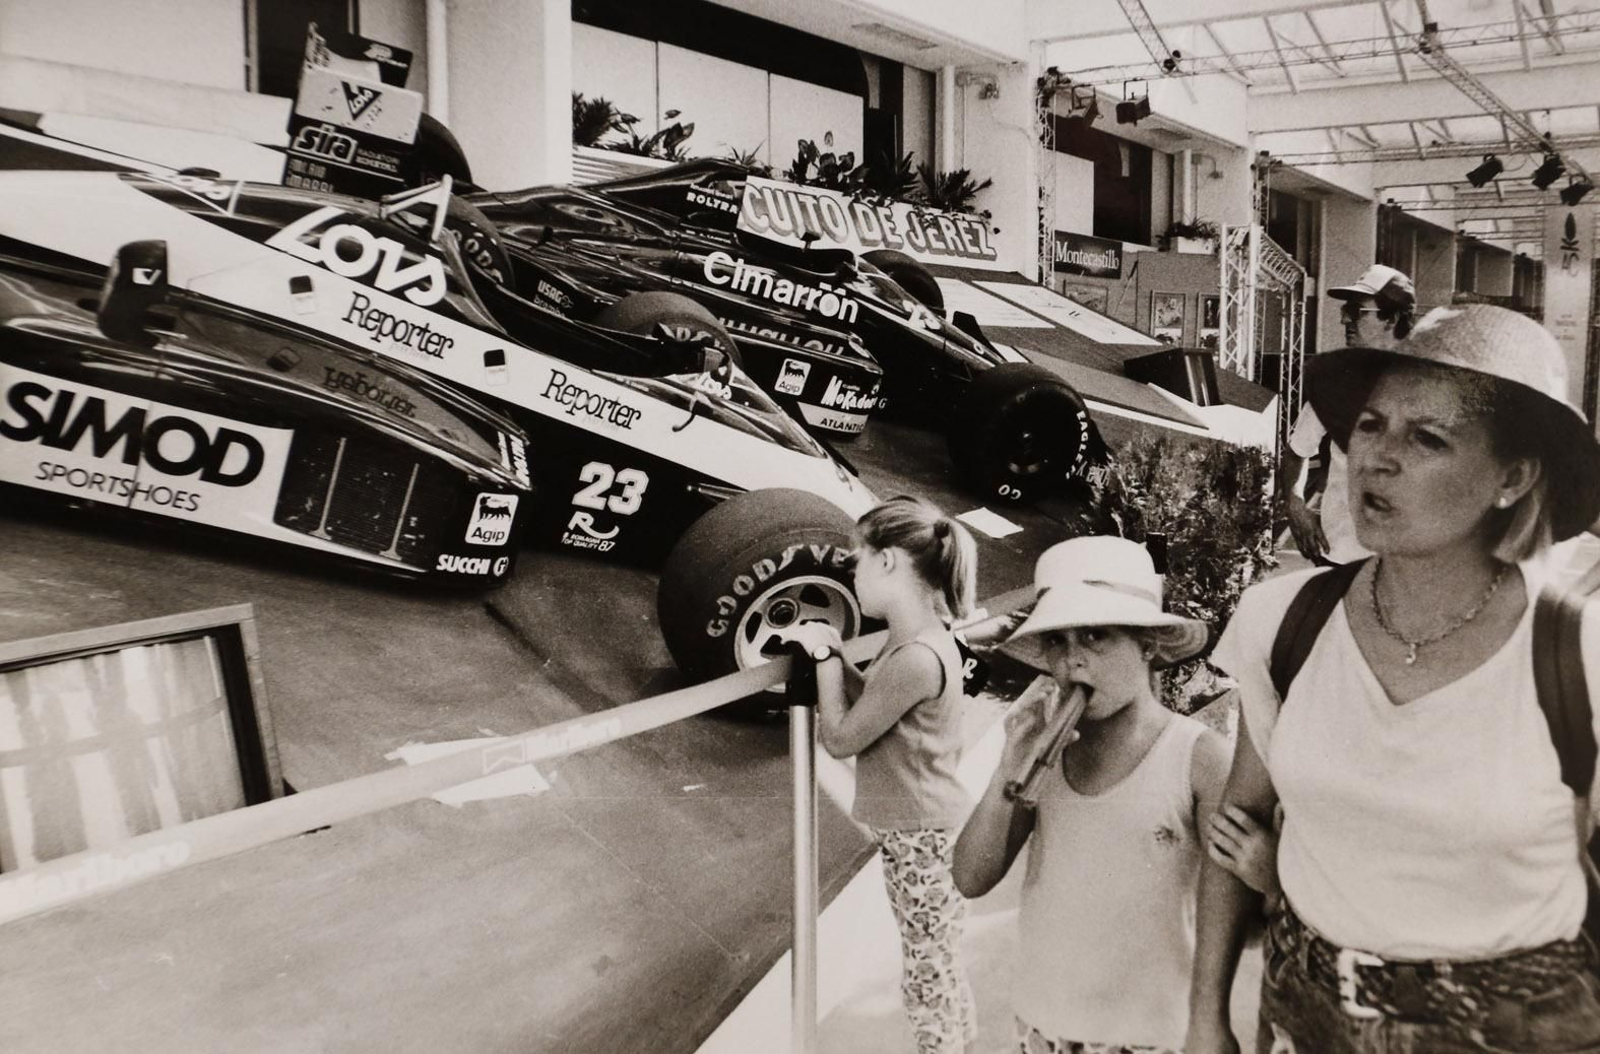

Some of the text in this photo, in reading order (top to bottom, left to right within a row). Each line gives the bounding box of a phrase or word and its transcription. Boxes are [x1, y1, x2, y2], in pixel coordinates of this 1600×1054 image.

[686, 192, 738, 215] ROLTRA
[851, 202, 903, 249] DE
[1055, 240, 1120, 270] Montecastillo
[341, 291, 454, 359] Reporter
[540, 368, 642, 430] Reporter
[0, 381, 265, 488] SIMOD
[35, 460, 201, 512] SPORTSHOES
[571, 461, 649, 515] 23
[471, 527, 505, 543] Agip
[598, 540, 615, 552] 87
[436, 554, 491, 575] SUCCHI
